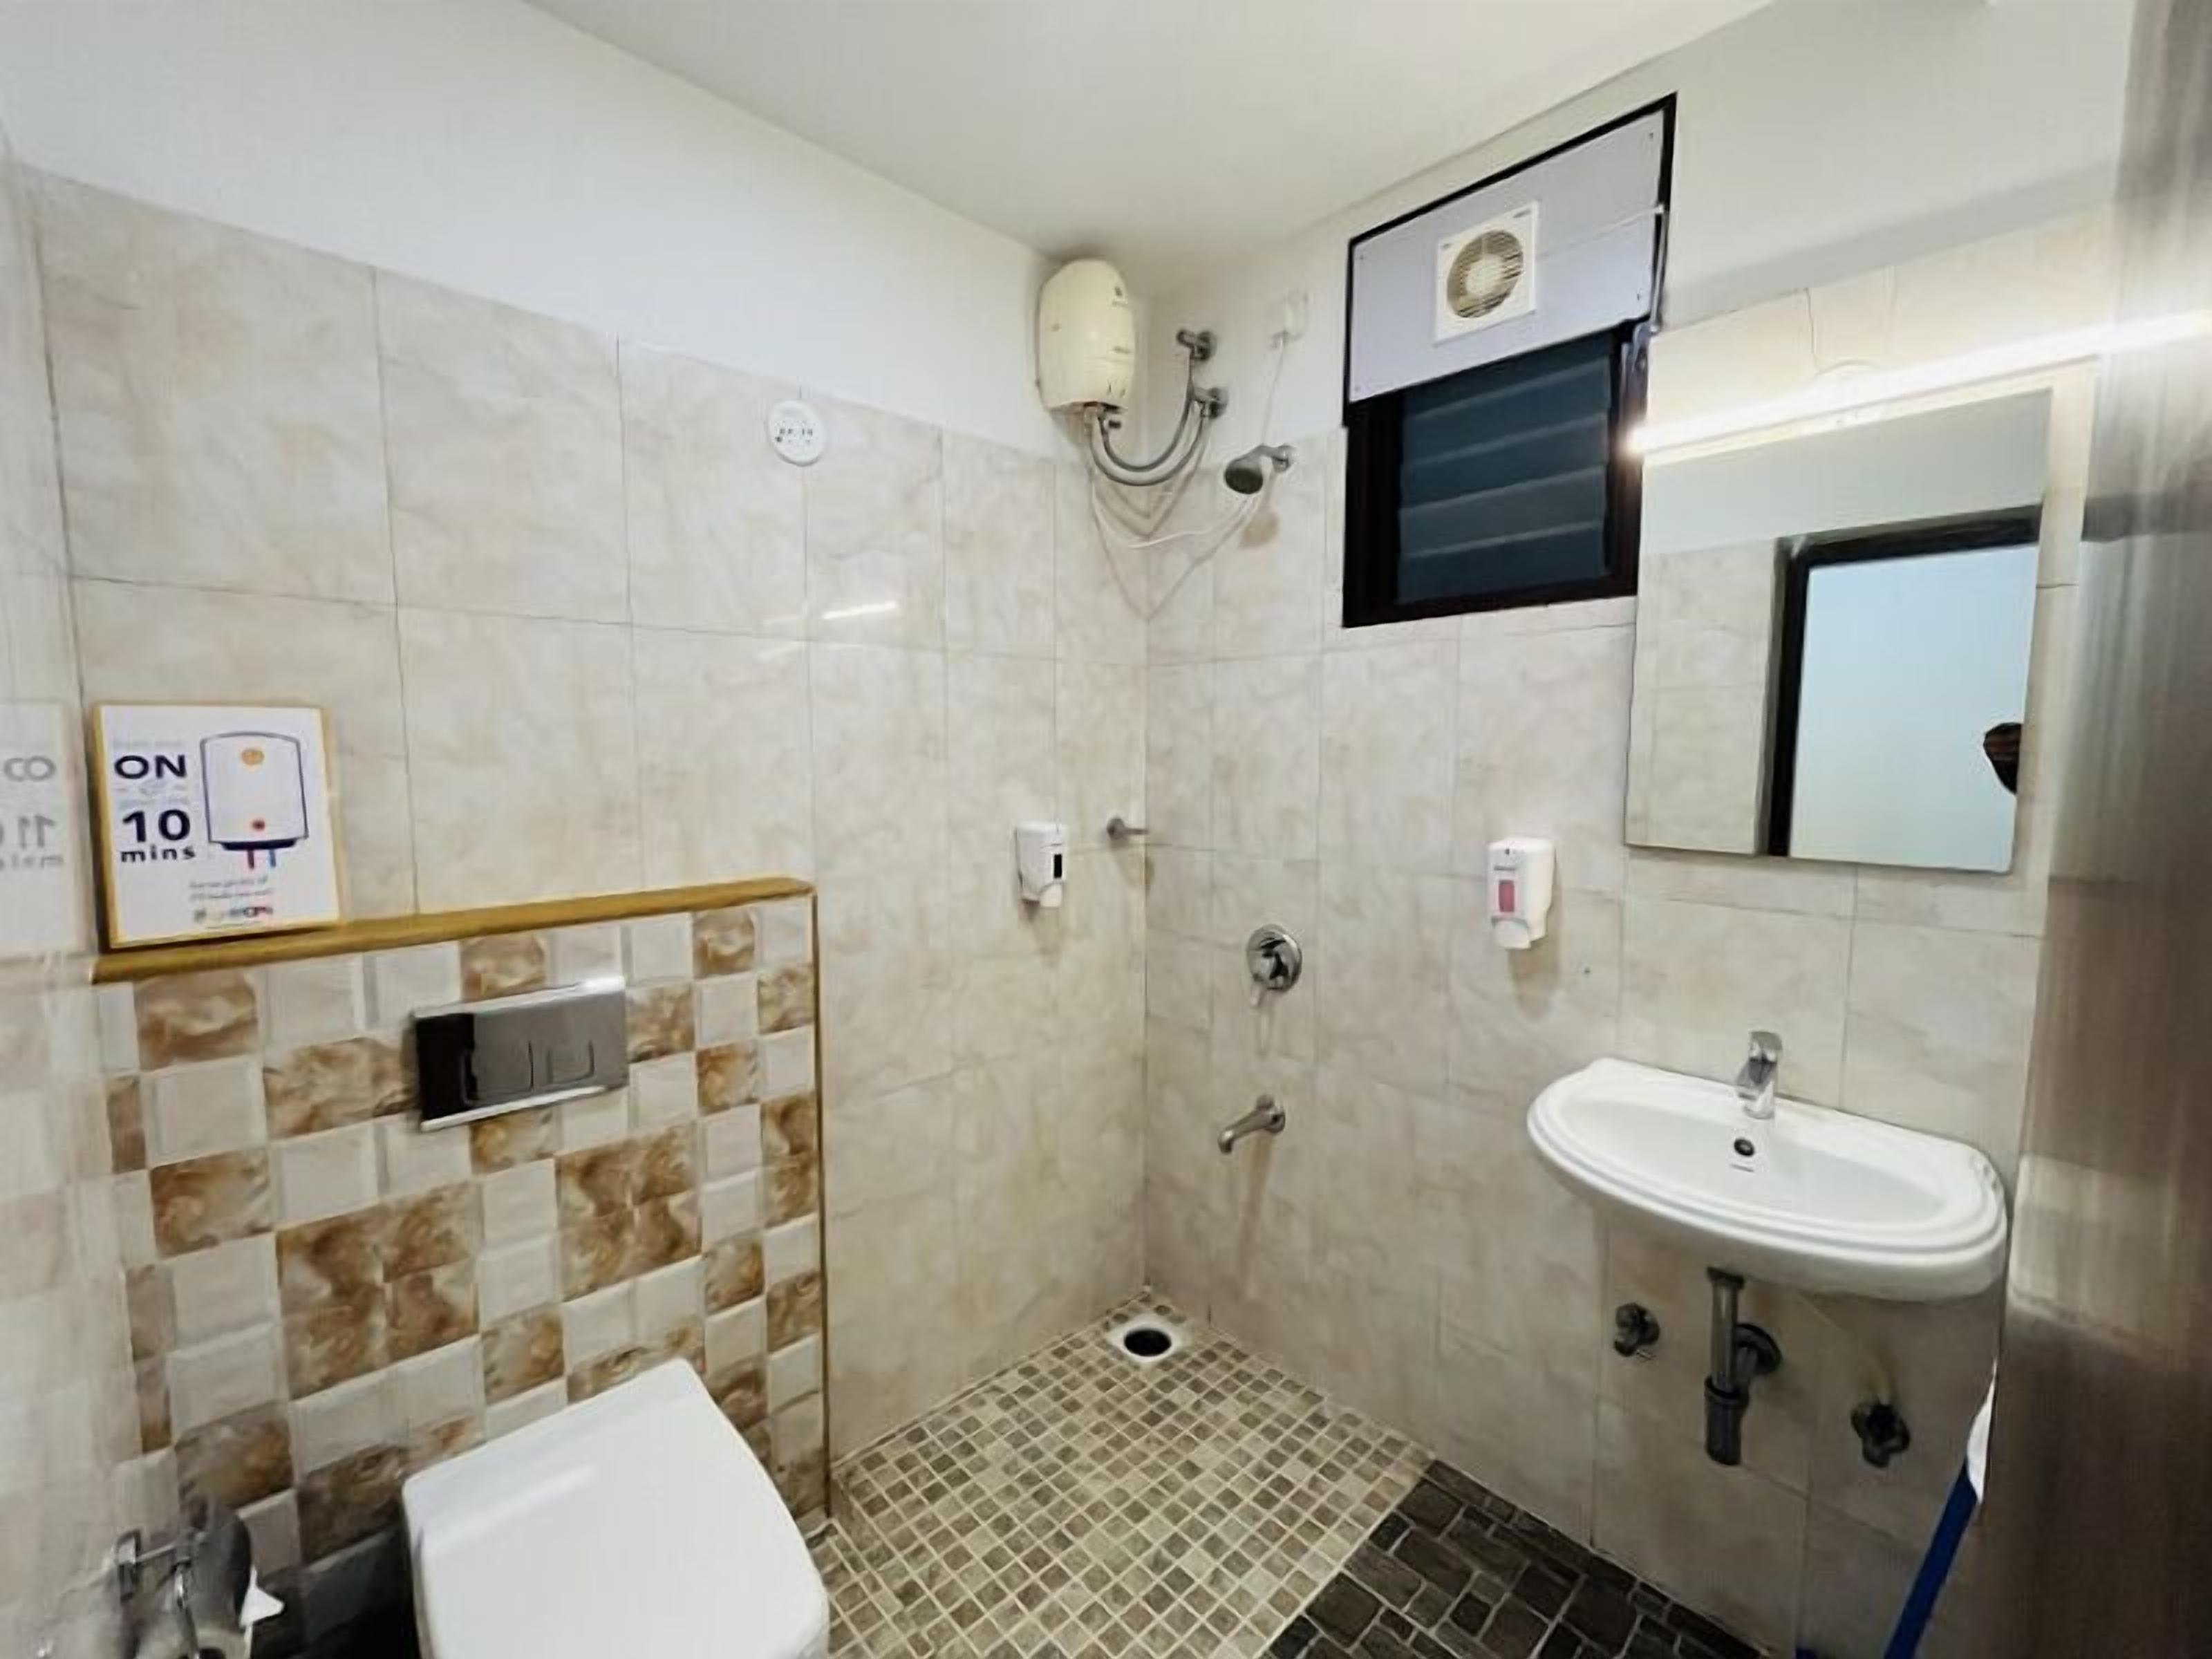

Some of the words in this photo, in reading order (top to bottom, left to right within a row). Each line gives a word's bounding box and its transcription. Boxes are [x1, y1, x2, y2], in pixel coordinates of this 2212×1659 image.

[114, 754, 187, 780] ON
[122, 809, 190, 842] 10
[120, 845, 196, 863] mins
